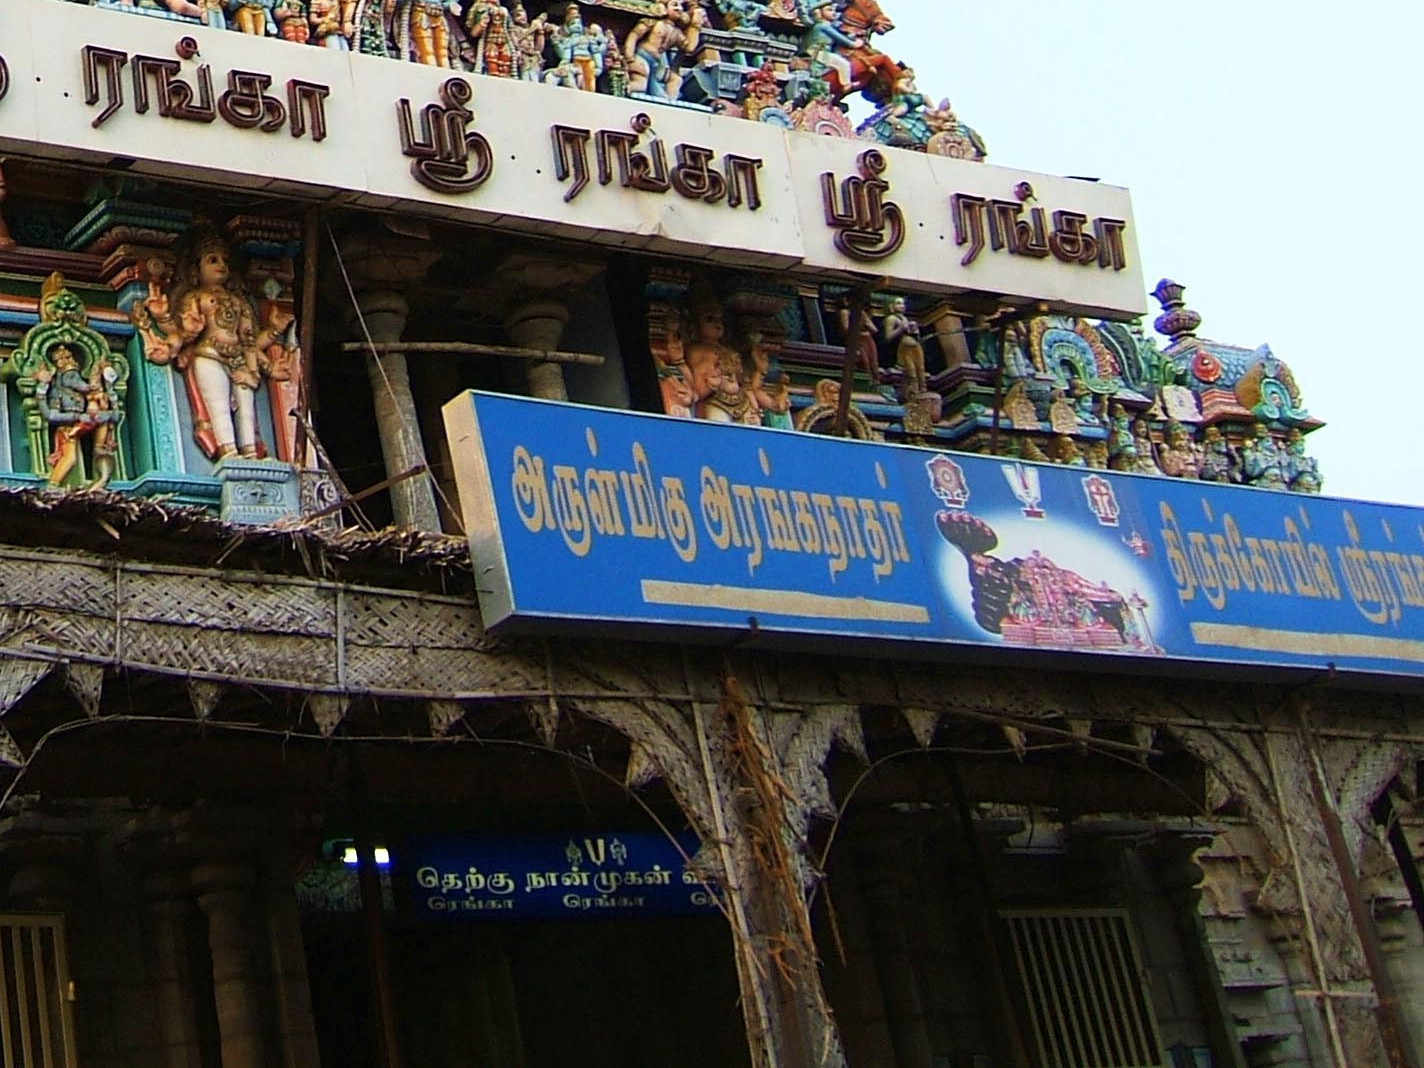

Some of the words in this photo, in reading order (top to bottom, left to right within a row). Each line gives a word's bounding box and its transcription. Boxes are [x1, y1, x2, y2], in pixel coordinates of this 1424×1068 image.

[80, 35, 330, 143] ரங்கா
[549, 112, 764, 211] ரங்கா
[950, 180, 1127, 271] ரங்கா
[512, 426, 697, 563] அருள்மிகு
[700, 447, 911, 584] அரங்கநாதர்
[1159, 498, 1341, 611] திருக்கோயில்
[416, 866, 516, 894] தெற்கு
[525, 864, 672, 894] நான்முகன்
